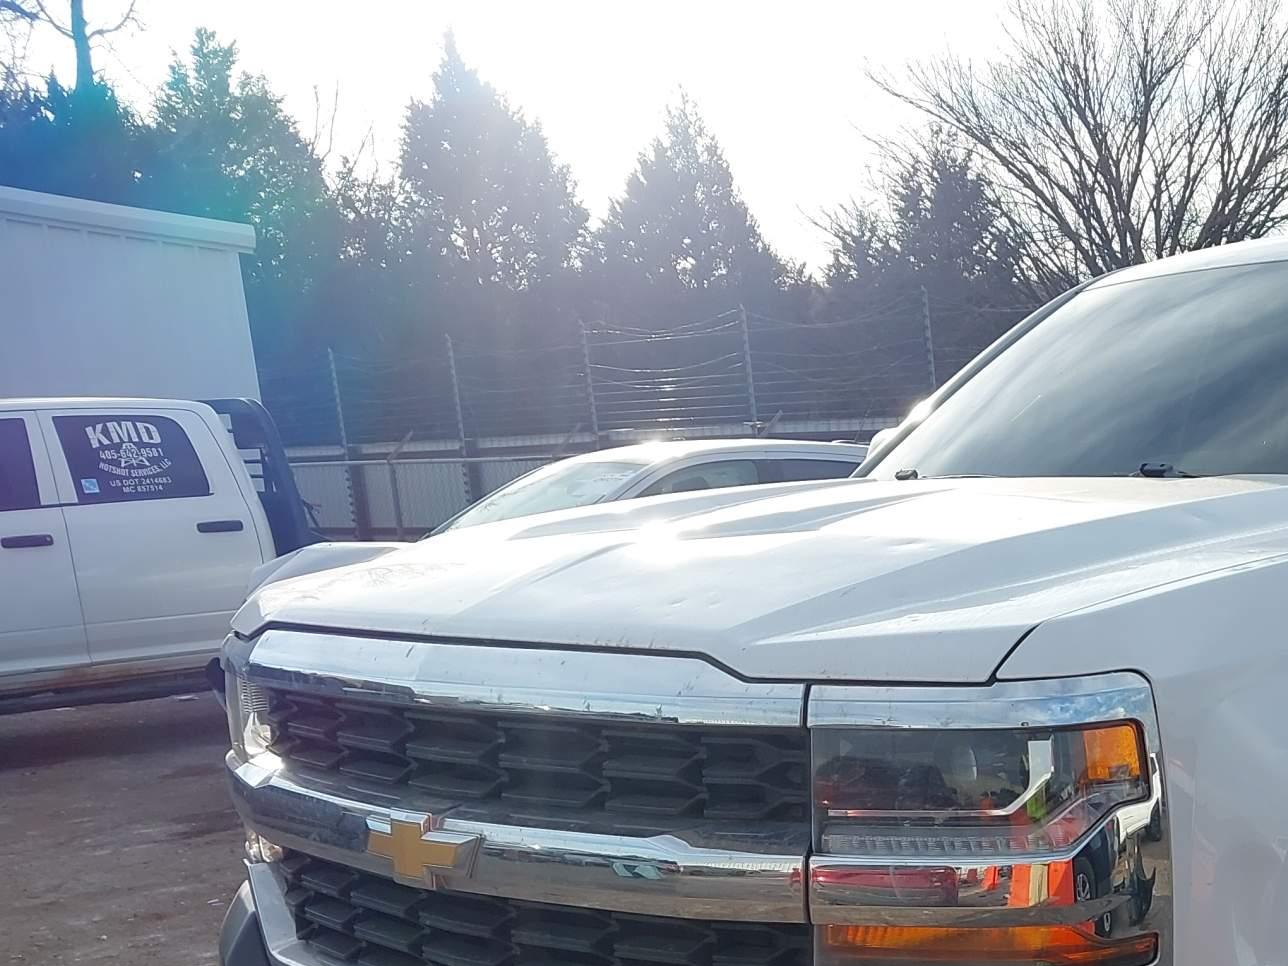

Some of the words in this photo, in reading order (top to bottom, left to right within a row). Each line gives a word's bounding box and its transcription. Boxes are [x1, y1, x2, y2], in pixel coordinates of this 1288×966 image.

[85, 421, 162, 448] KMD
[99, 448, 164, 460] 405-642-9581
[99, 462, 129, 476] HOTSHOT
